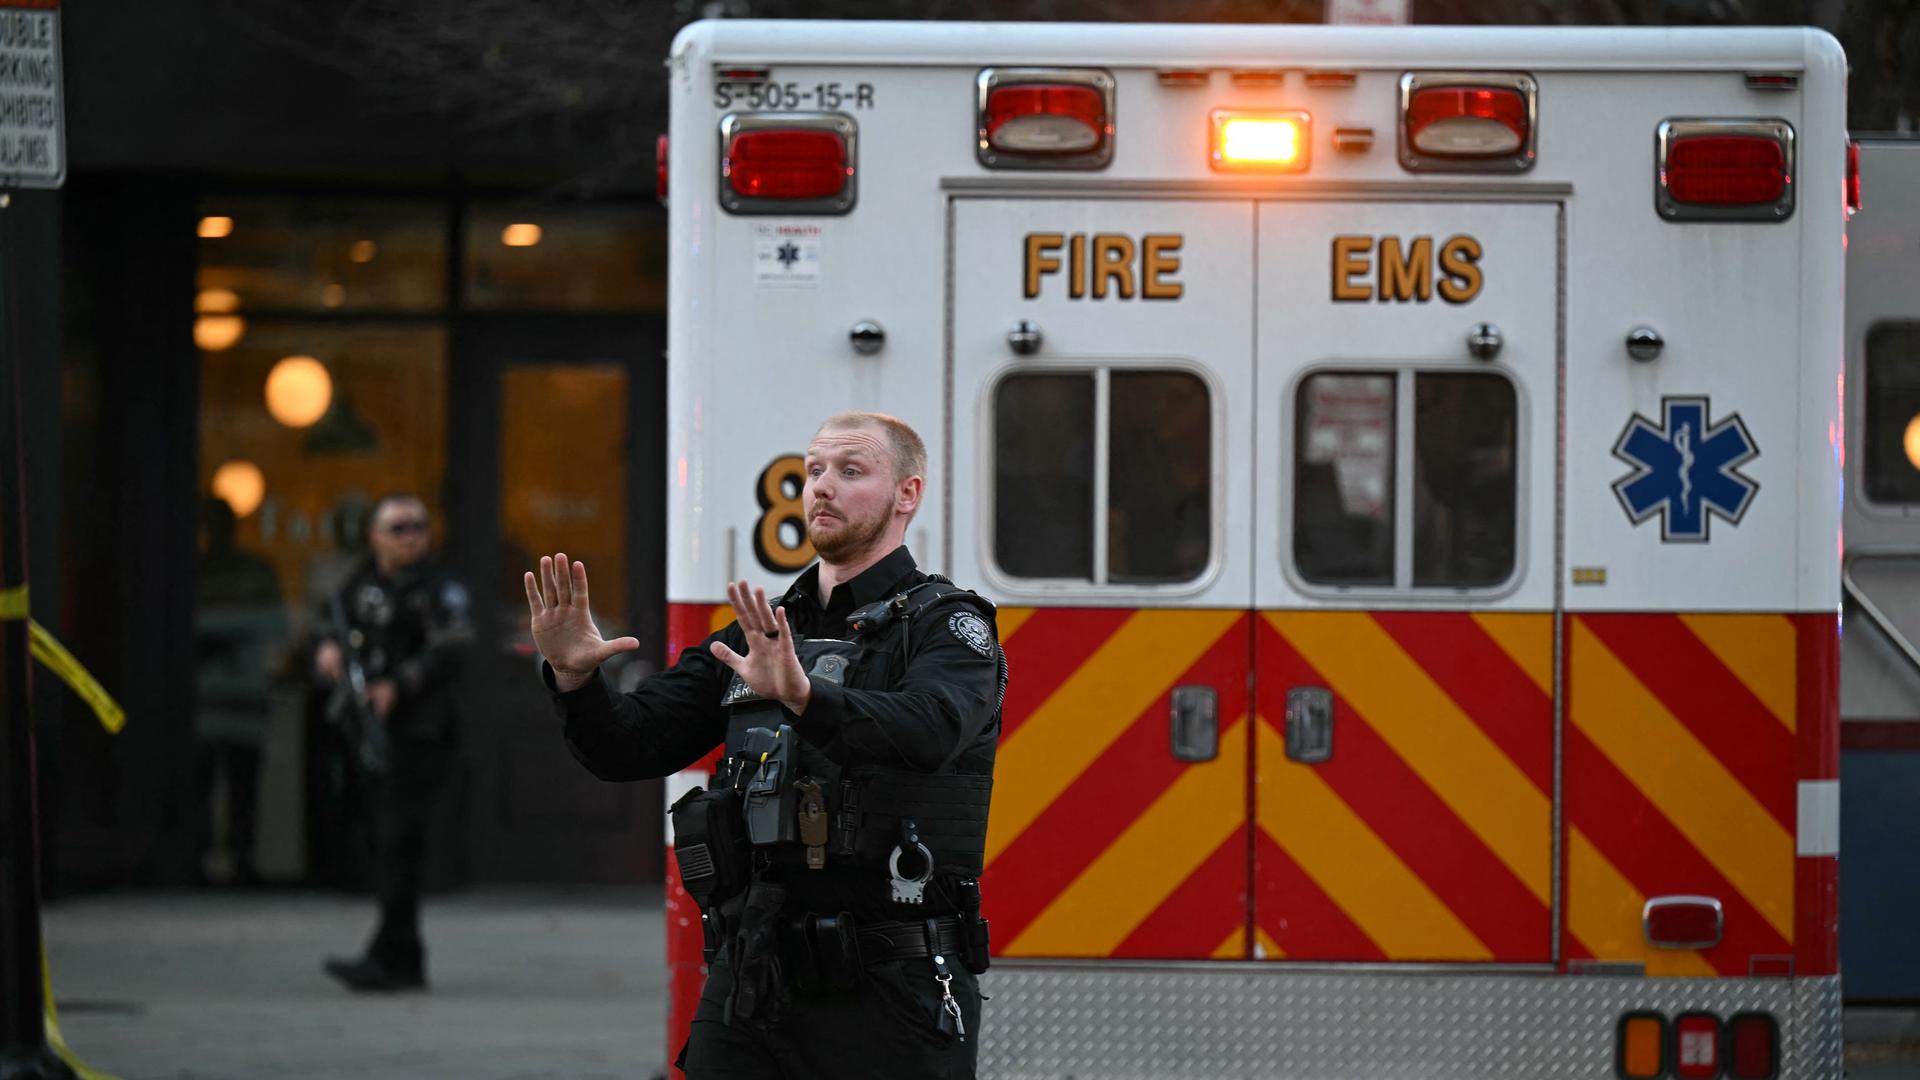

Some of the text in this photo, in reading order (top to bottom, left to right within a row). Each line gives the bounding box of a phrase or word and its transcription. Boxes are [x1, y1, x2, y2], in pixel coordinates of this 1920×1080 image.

[713, 82, 874, 109] S-505-15-R
[1023, 233, 1484, 304] FIRE EMS
[753, 453, 817, 574] 8
